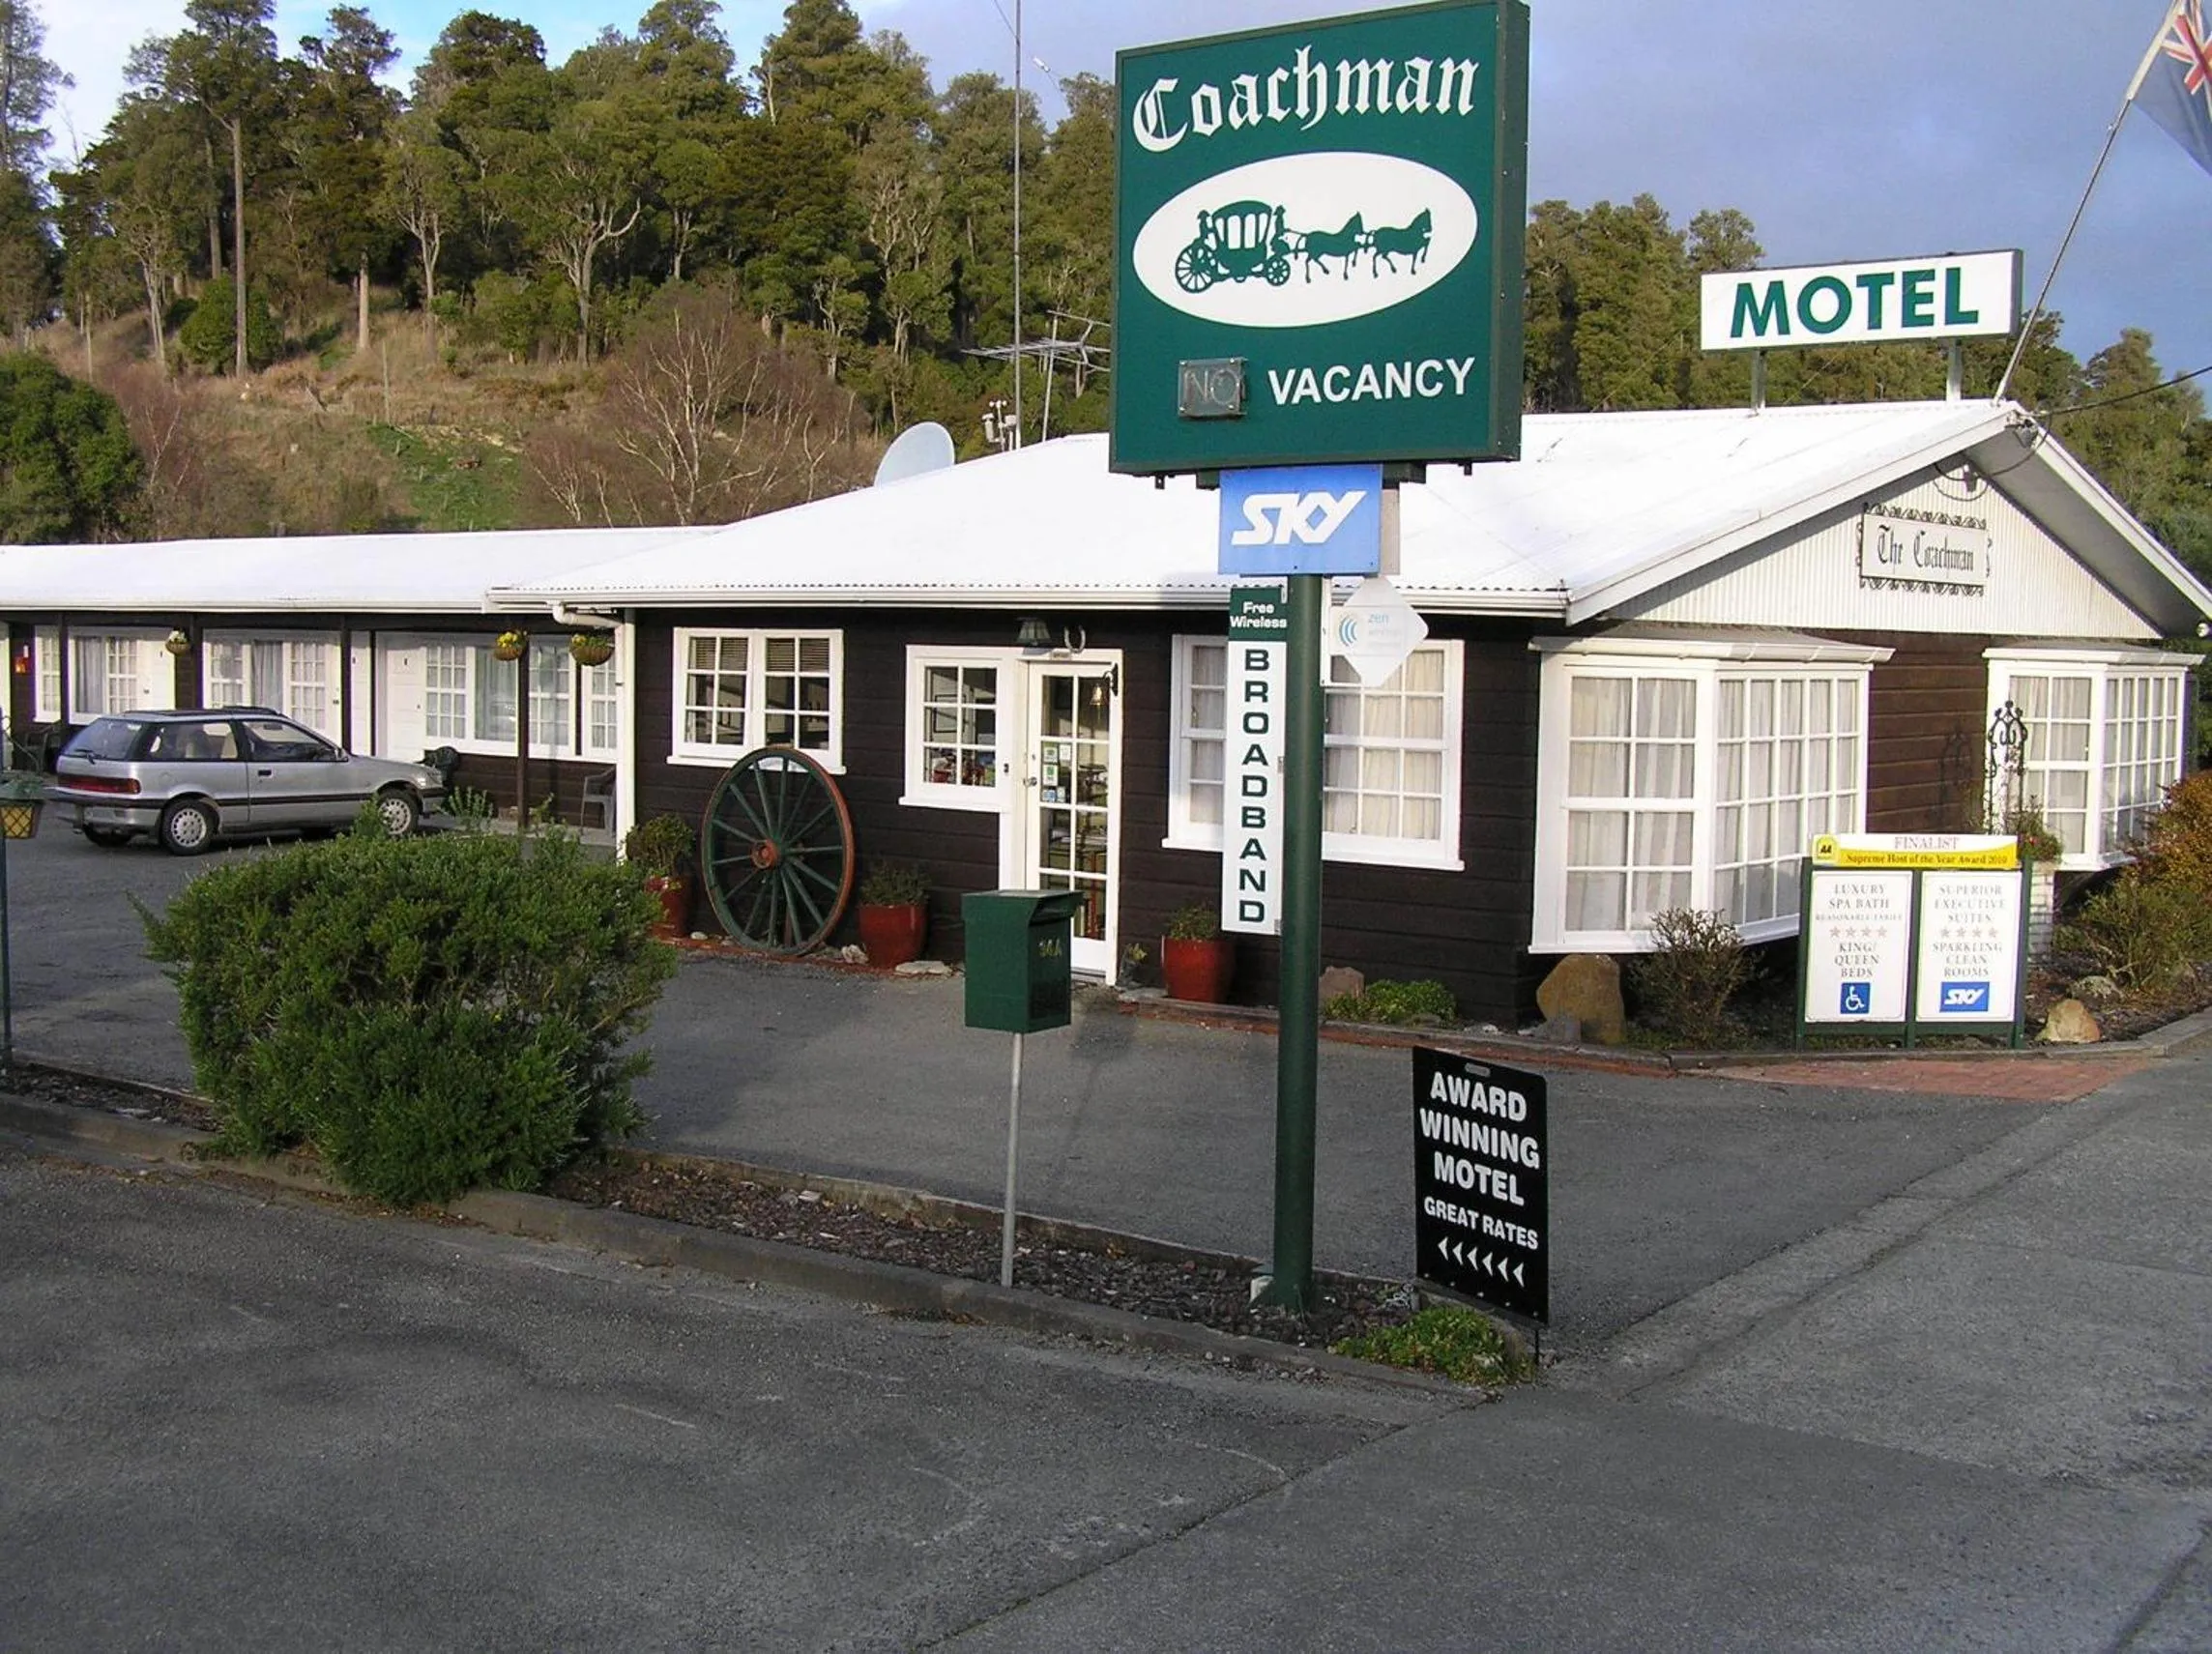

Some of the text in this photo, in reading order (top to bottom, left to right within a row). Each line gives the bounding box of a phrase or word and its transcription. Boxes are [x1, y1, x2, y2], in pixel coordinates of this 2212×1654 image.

[1133, 44, 1479, 152] Coachman
[1730, 267, 1978, 337] MOTEL
[1183, 358, 1475, 405] NO VACANCY
[1231, 490, 1368, 545] SKY
[1877, 525, 1974, 572] The Coachman
[1242, 601, 1275, 615] Free
[1230, 616, 1288, 628] Wireless
[1238, 649, 1270, 922] BROADBAND
[1894, 836, 1961, 850] FINALIST
[1847, 855, 1885, 865] Supreme
[1888, 855, 1906, 864] Host
[1909, 855, 1919, 864] of
[1920, 855, 1934, 864] the
[1936, 855, 1957, 865] Year
[1959, 856, 1986, 865] Award
[1834, 884, 1886, 895] LUXURY
[1939, 885, 2002, 895] SUPERIOR
[1829, 897, 1890, 909] SPA BATH
[1934, 898, 2006, 910] EXECUTIVE
[1948, 913, 1992, 923] SUITES
[1932, 943, 2002, 953] SPARKLING
[1834, 954, 1879, 966] QUEEN
[1945, 955, 1988, 966] CLEAN
[1841, 967, 1874, 977] BEDS
[1943, 967, 1989, 977] ROOMS
[1944, 989, 1985, 1005] SKY
[1430, 1071, 1528, 1122] AWARD
[1419, 1108, 1540, 1169] WINNING
[1434, 1151, 1525, 1206] MOTEL
[1424, 1196, 1538, 1250] GREAT RATES
